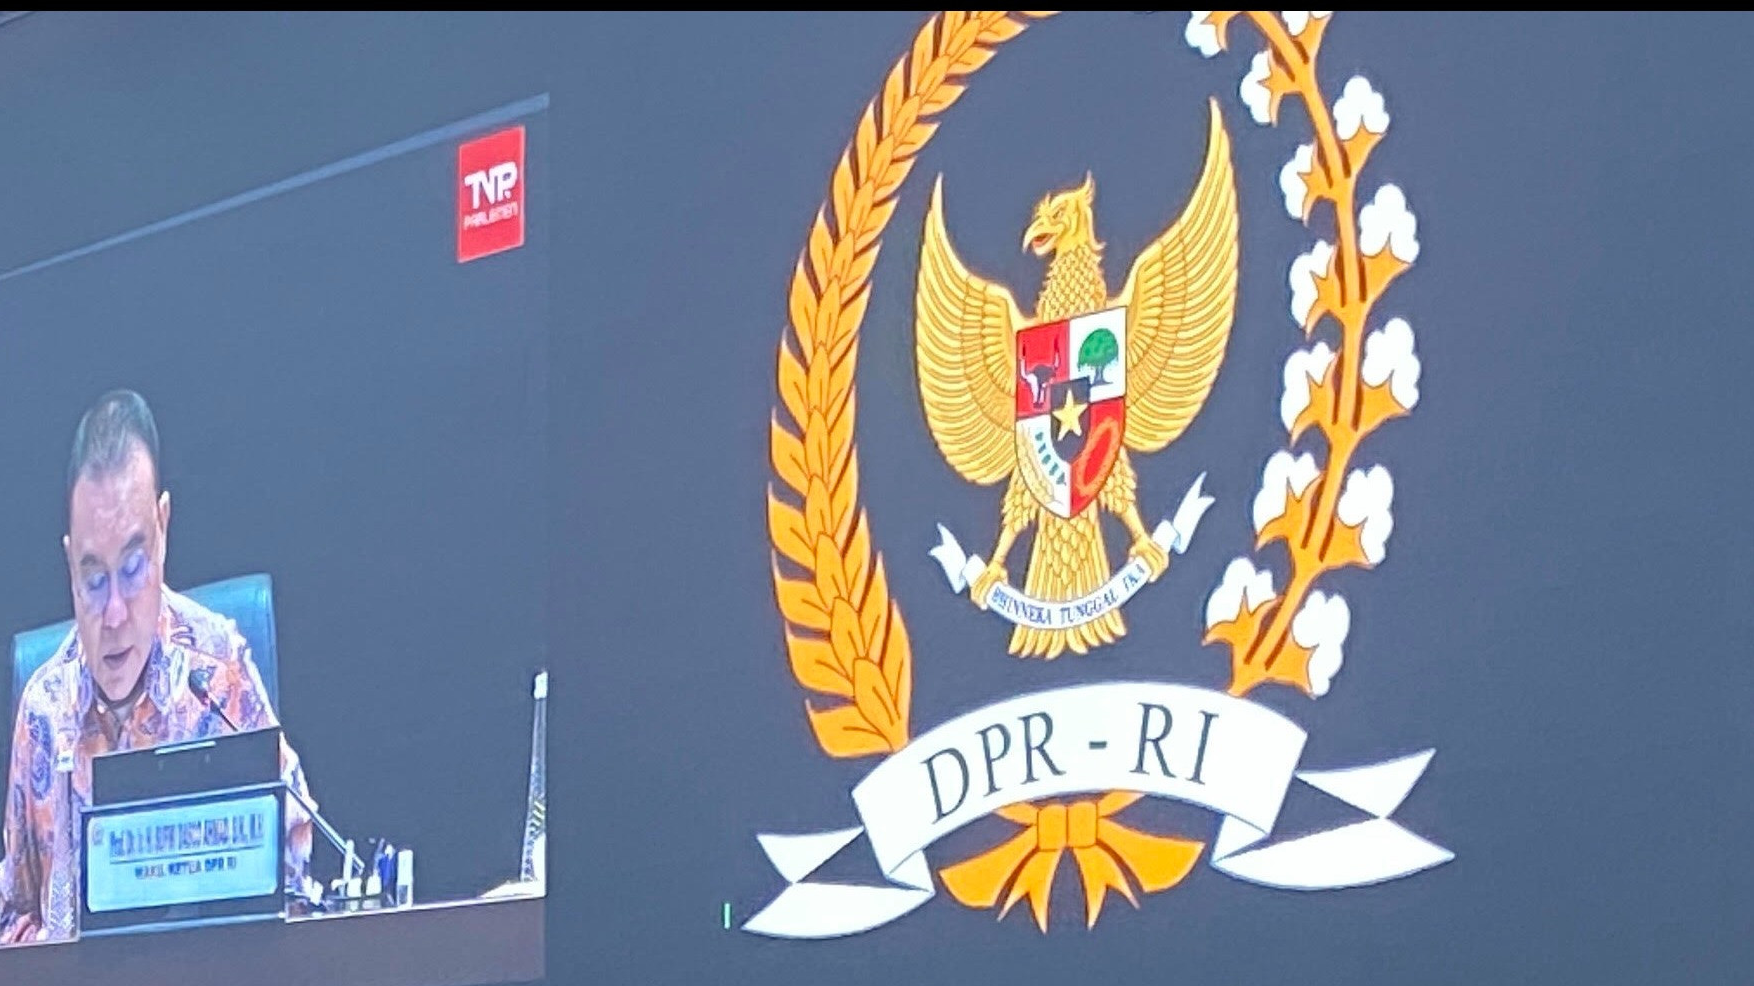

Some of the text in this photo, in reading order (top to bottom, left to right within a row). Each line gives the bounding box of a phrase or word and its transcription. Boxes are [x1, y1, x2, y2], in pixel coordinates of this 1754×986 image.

[1060, 587, 1118, 625] TUNGGAL
[921, 711, 1065, 824] DPR
[1130, 702, 1219, 786] RI
